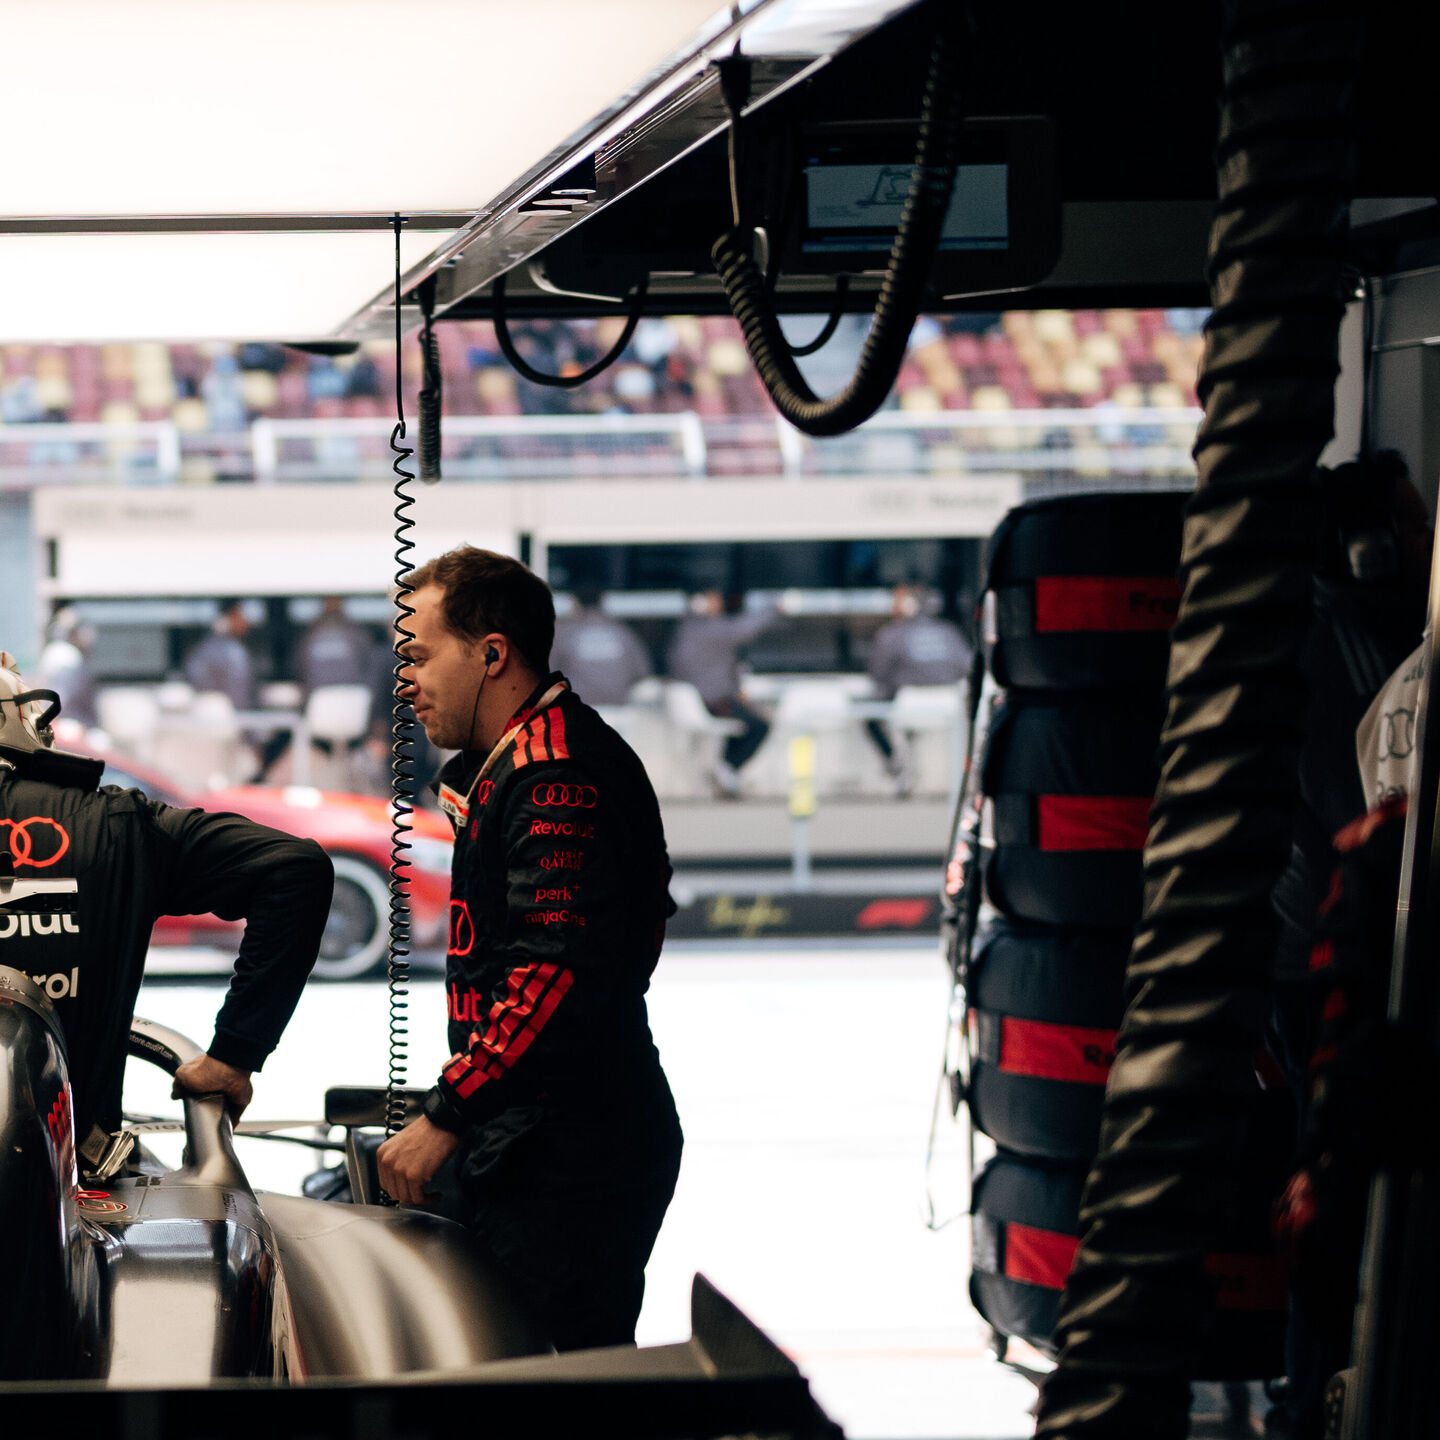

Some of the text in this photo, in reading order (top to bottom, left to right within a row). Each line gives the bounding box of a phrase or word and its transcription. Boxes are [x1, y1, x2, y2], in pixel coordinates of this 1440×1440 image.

[529, 819, 596, 838] Revolut
[540, 857, 582, 872] QATAR
[524, 910, 587, 926] ninjaOne
